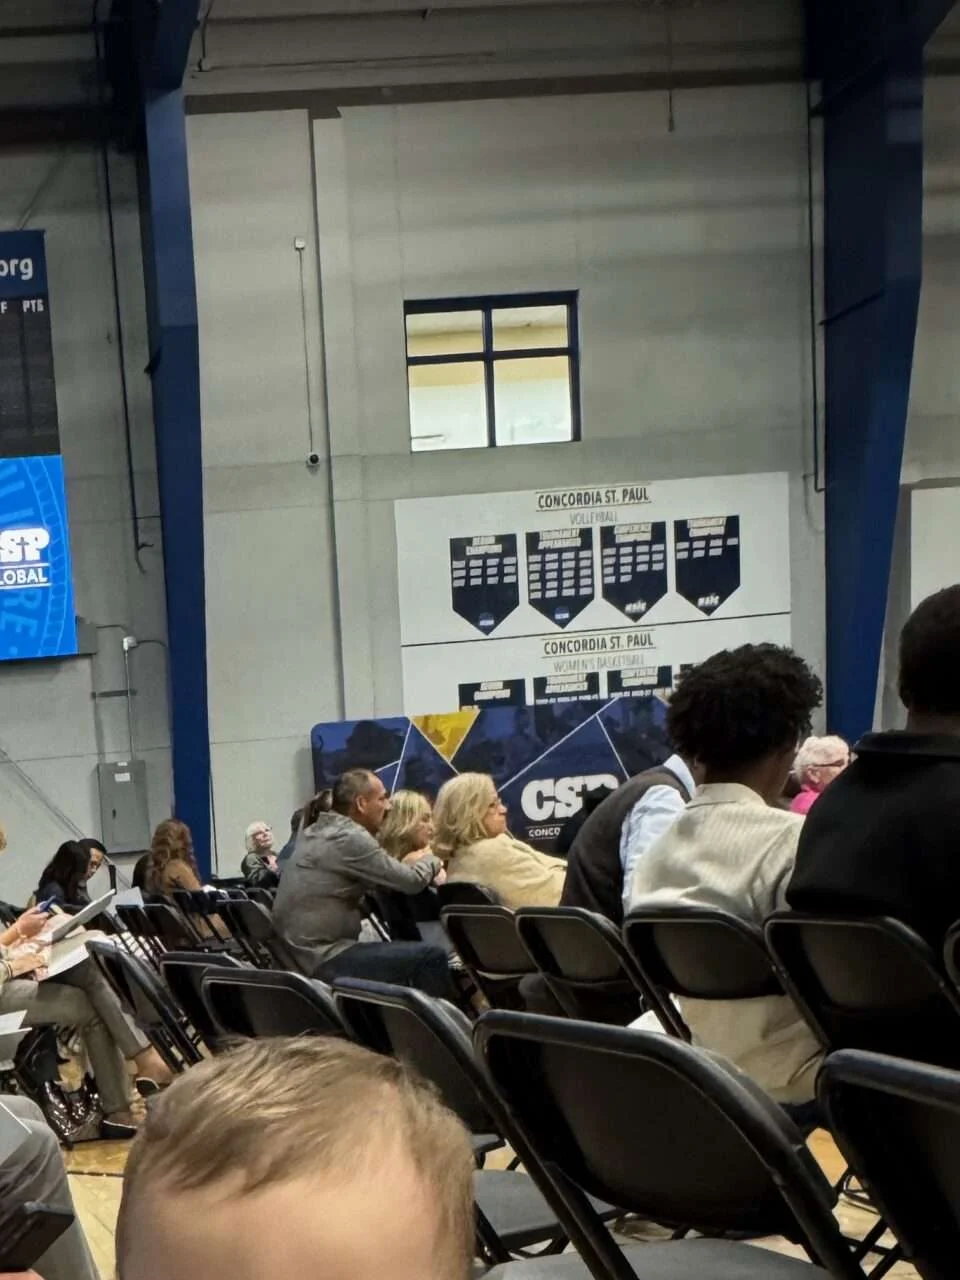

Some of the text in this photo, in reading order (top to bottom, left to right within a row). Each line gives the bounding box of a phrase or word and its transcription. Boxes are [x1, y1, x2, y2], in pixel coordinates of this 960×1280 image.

[0, 301, 8, 314] F
[538, 487, 650, 509] CONCORDIA ST. PAUL
[544, 632, 654, 655] CONCORDIA ST. PAUL
[528, 827, 561, 838] CONCO
